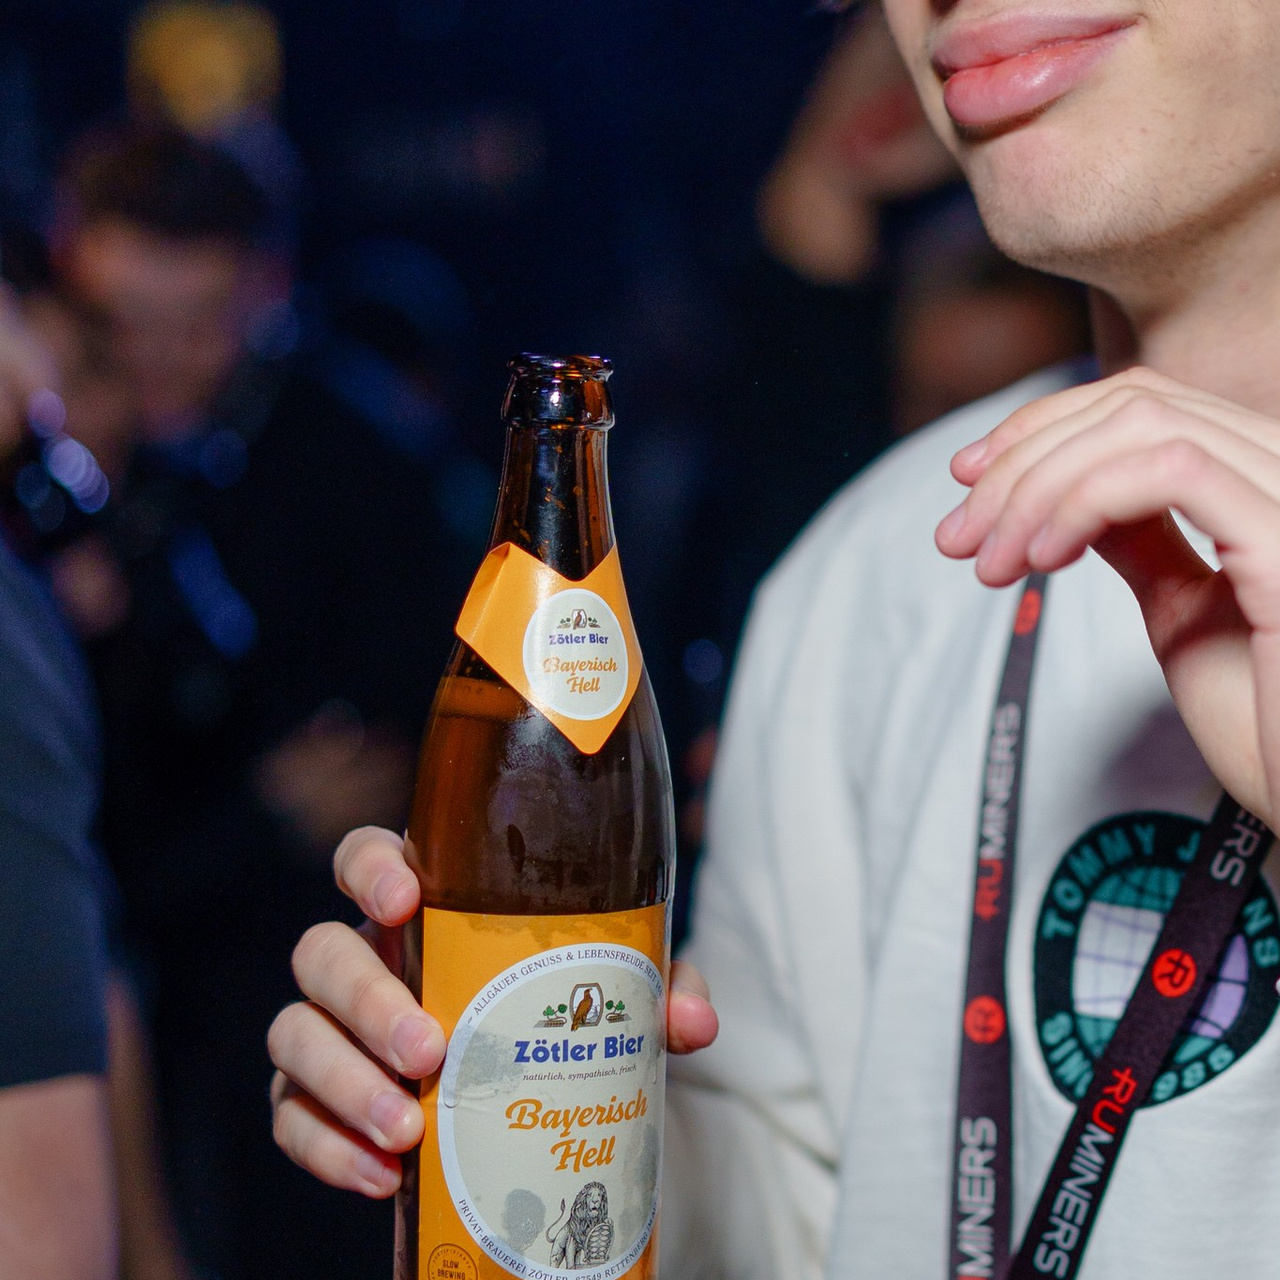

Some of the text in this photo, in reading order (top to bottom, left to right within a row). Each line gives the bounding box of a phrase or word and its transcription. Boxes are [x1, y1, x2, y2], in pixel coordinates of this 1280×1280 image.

[549, 632, 609, 646] Zötler Bier
[542, 656, 618, 676] Bayerisch
[566, 676, 601, 694] Hell
[1042, 824, 1156, 940] TOMMY
[472, 949, 657, 1015] ALLGÄUER GENUSS & LEBENSFREUDE SEIT
[514, 1032, 645, 1063] Zötler Bier
[523, 1071, 566, 1081] natürlich,
[567, 1067, 618, 1081] sympathisch,
[505, 1088, 649, 1137] Bayerisch
[550, 1136, 616, 1172] Hell
[1032, 1066, 1138, 1280] RUMINERS
[458, 1199, 527, 1274] PRIVAT-BRAUEREI
[605, 1233, 649, 1277] RETTENBERG
[437, 1269, 466, 1280] BREWING
[442, 1259, 459, 1269] SLOW
